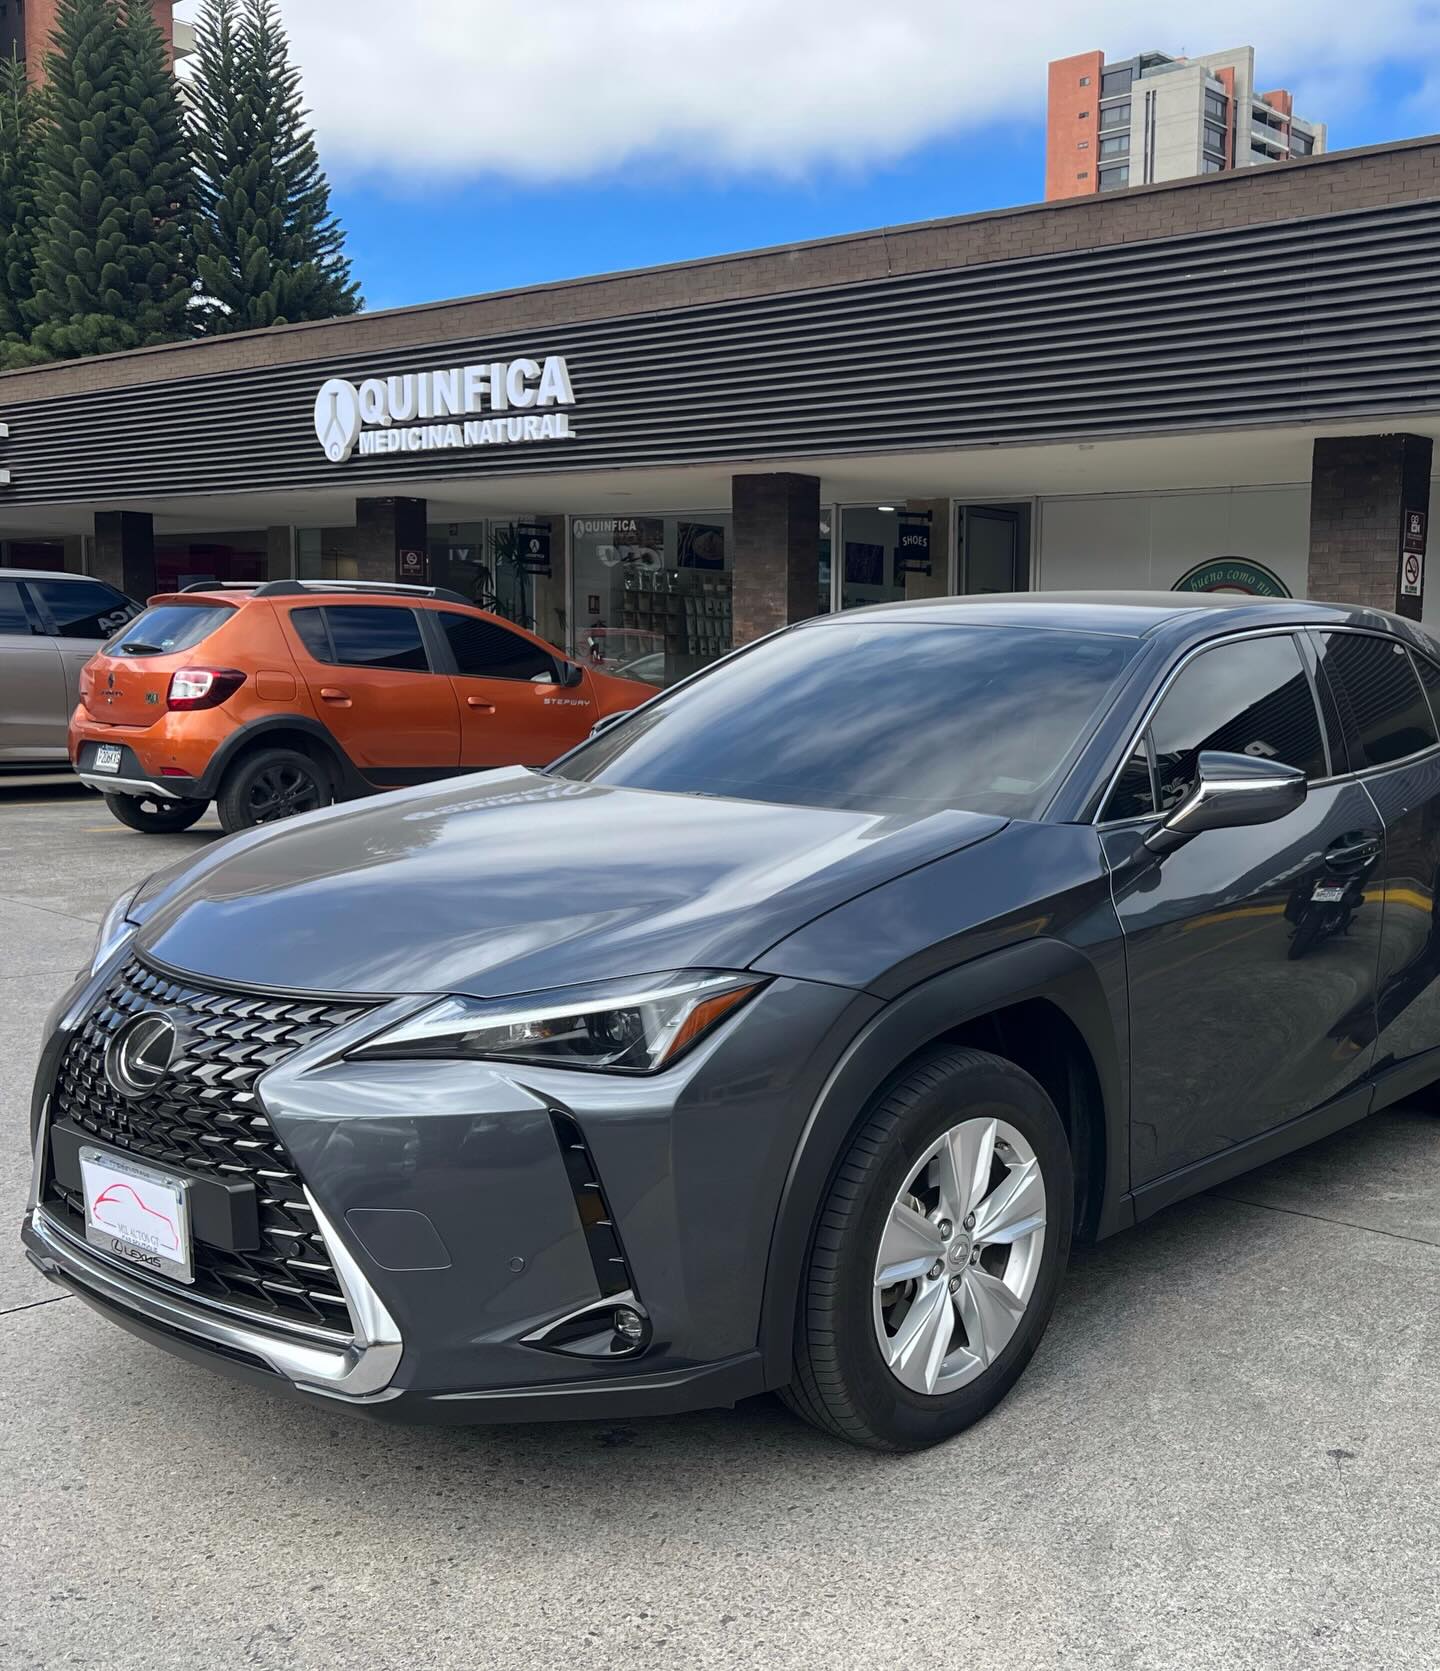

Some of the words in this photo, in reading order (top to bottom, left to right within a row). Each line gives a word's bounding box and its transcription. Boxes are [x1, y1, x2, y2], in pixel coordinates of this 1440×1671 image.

[357, 355, 575, 427] QUINFICA
[358, 423, 464, 455] MEDICINA
[463, 413, 576, 446] NATURAL
[584, 518, 638, 532] QUINFICA
[901, 535, 928, 548] SHOES
[1190, 569, 1224, 592] bueno
[1226, 568, 1256, 586] como
[543, 698, 591, 706] STEPWAY
[124, 1245, 162, 1268] LEXUS
